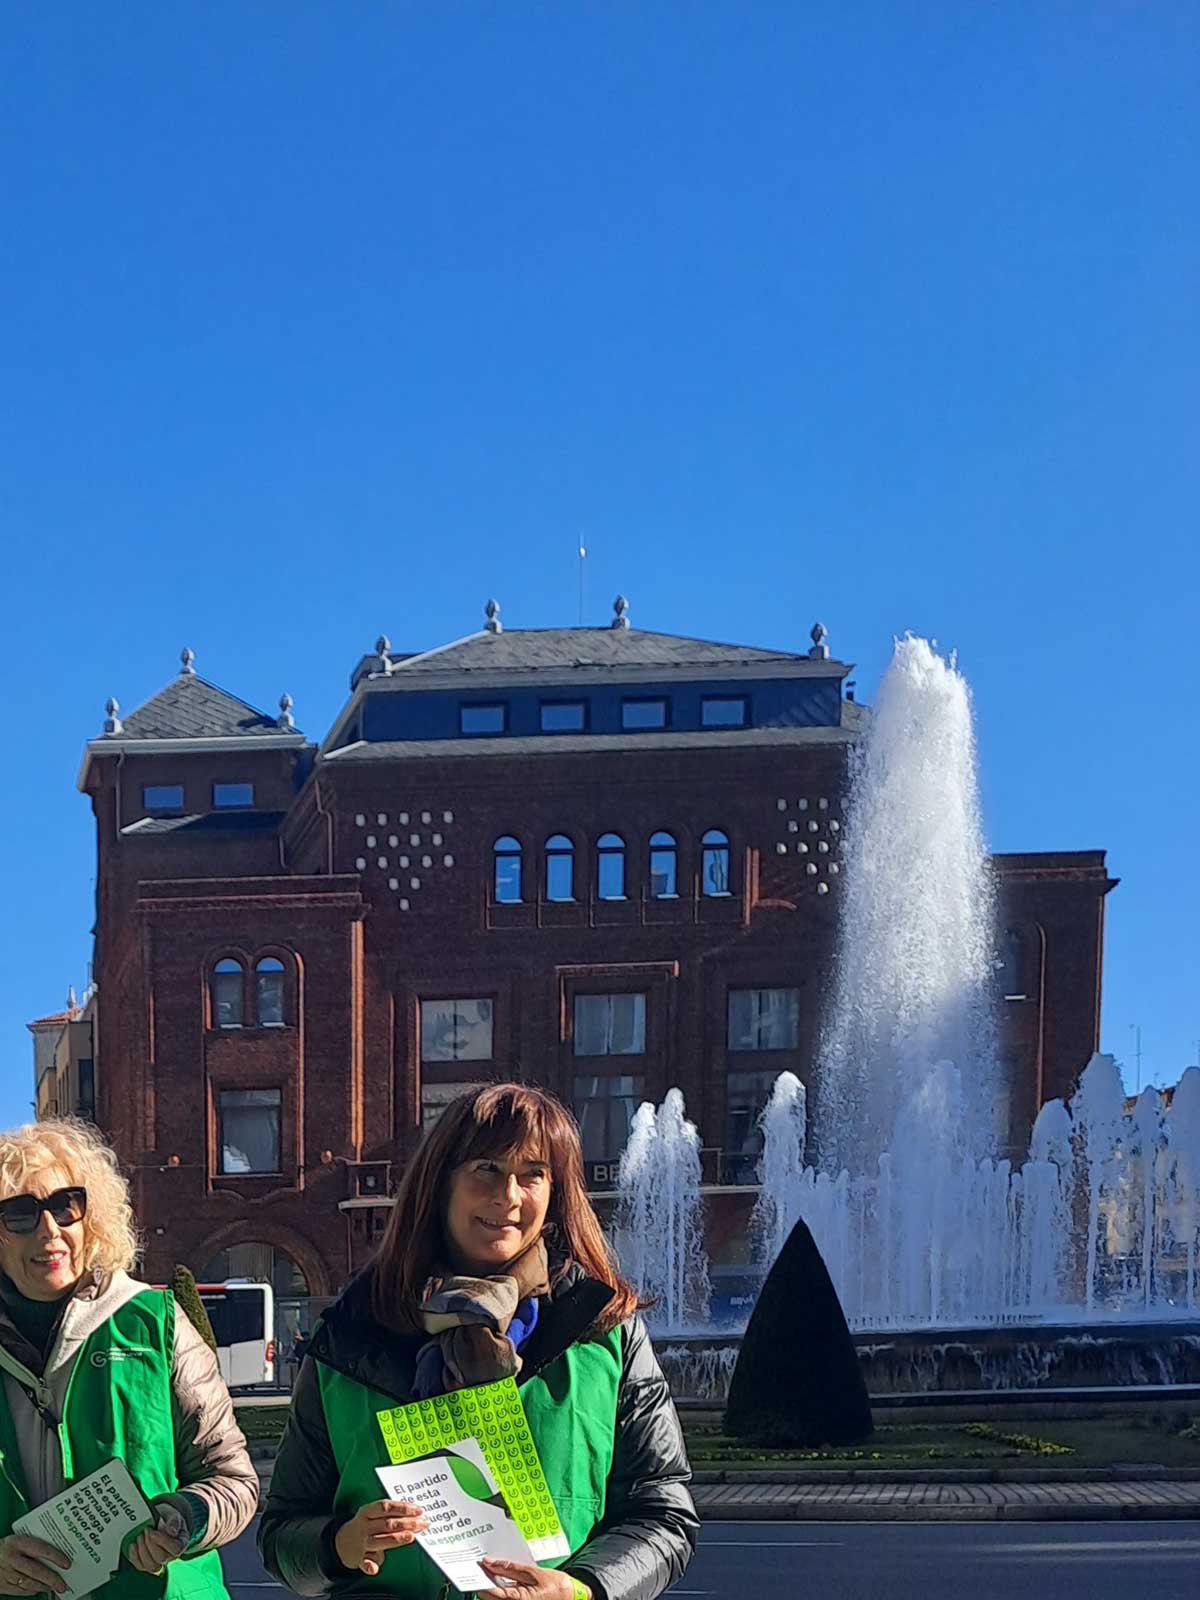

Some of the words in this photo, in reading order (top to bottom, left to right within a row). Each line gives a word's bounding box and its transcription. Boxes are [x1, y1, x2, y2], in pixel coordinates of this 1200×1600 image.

[91, 1481, 103, 1495] de
[101, 1493, 120, 1517] esta
[101, 1474, 113, 1486] El
[107, 1484, 137, 1522] partido
[394, 1484, 407, 1494] El
[408, 1472, 448, 1491] partido
[416, 1490, 441, 1502] esta
[64, 1498, 72, 1506] a
[69, 1505, 91, 1532] favor
[89, 1532, 101, 1546] de
[73, 1492, 85, 1505] se
[81, 1504, 104, 1533] juega
[80, 1485, 111, 1524] jornada
[456, 1516, 472, 1528] de
[55, 1503, 64, 1515] la
[64, 1515, 101, 1564] esperanza
[437, 1523, 494, 1546] esperanza
